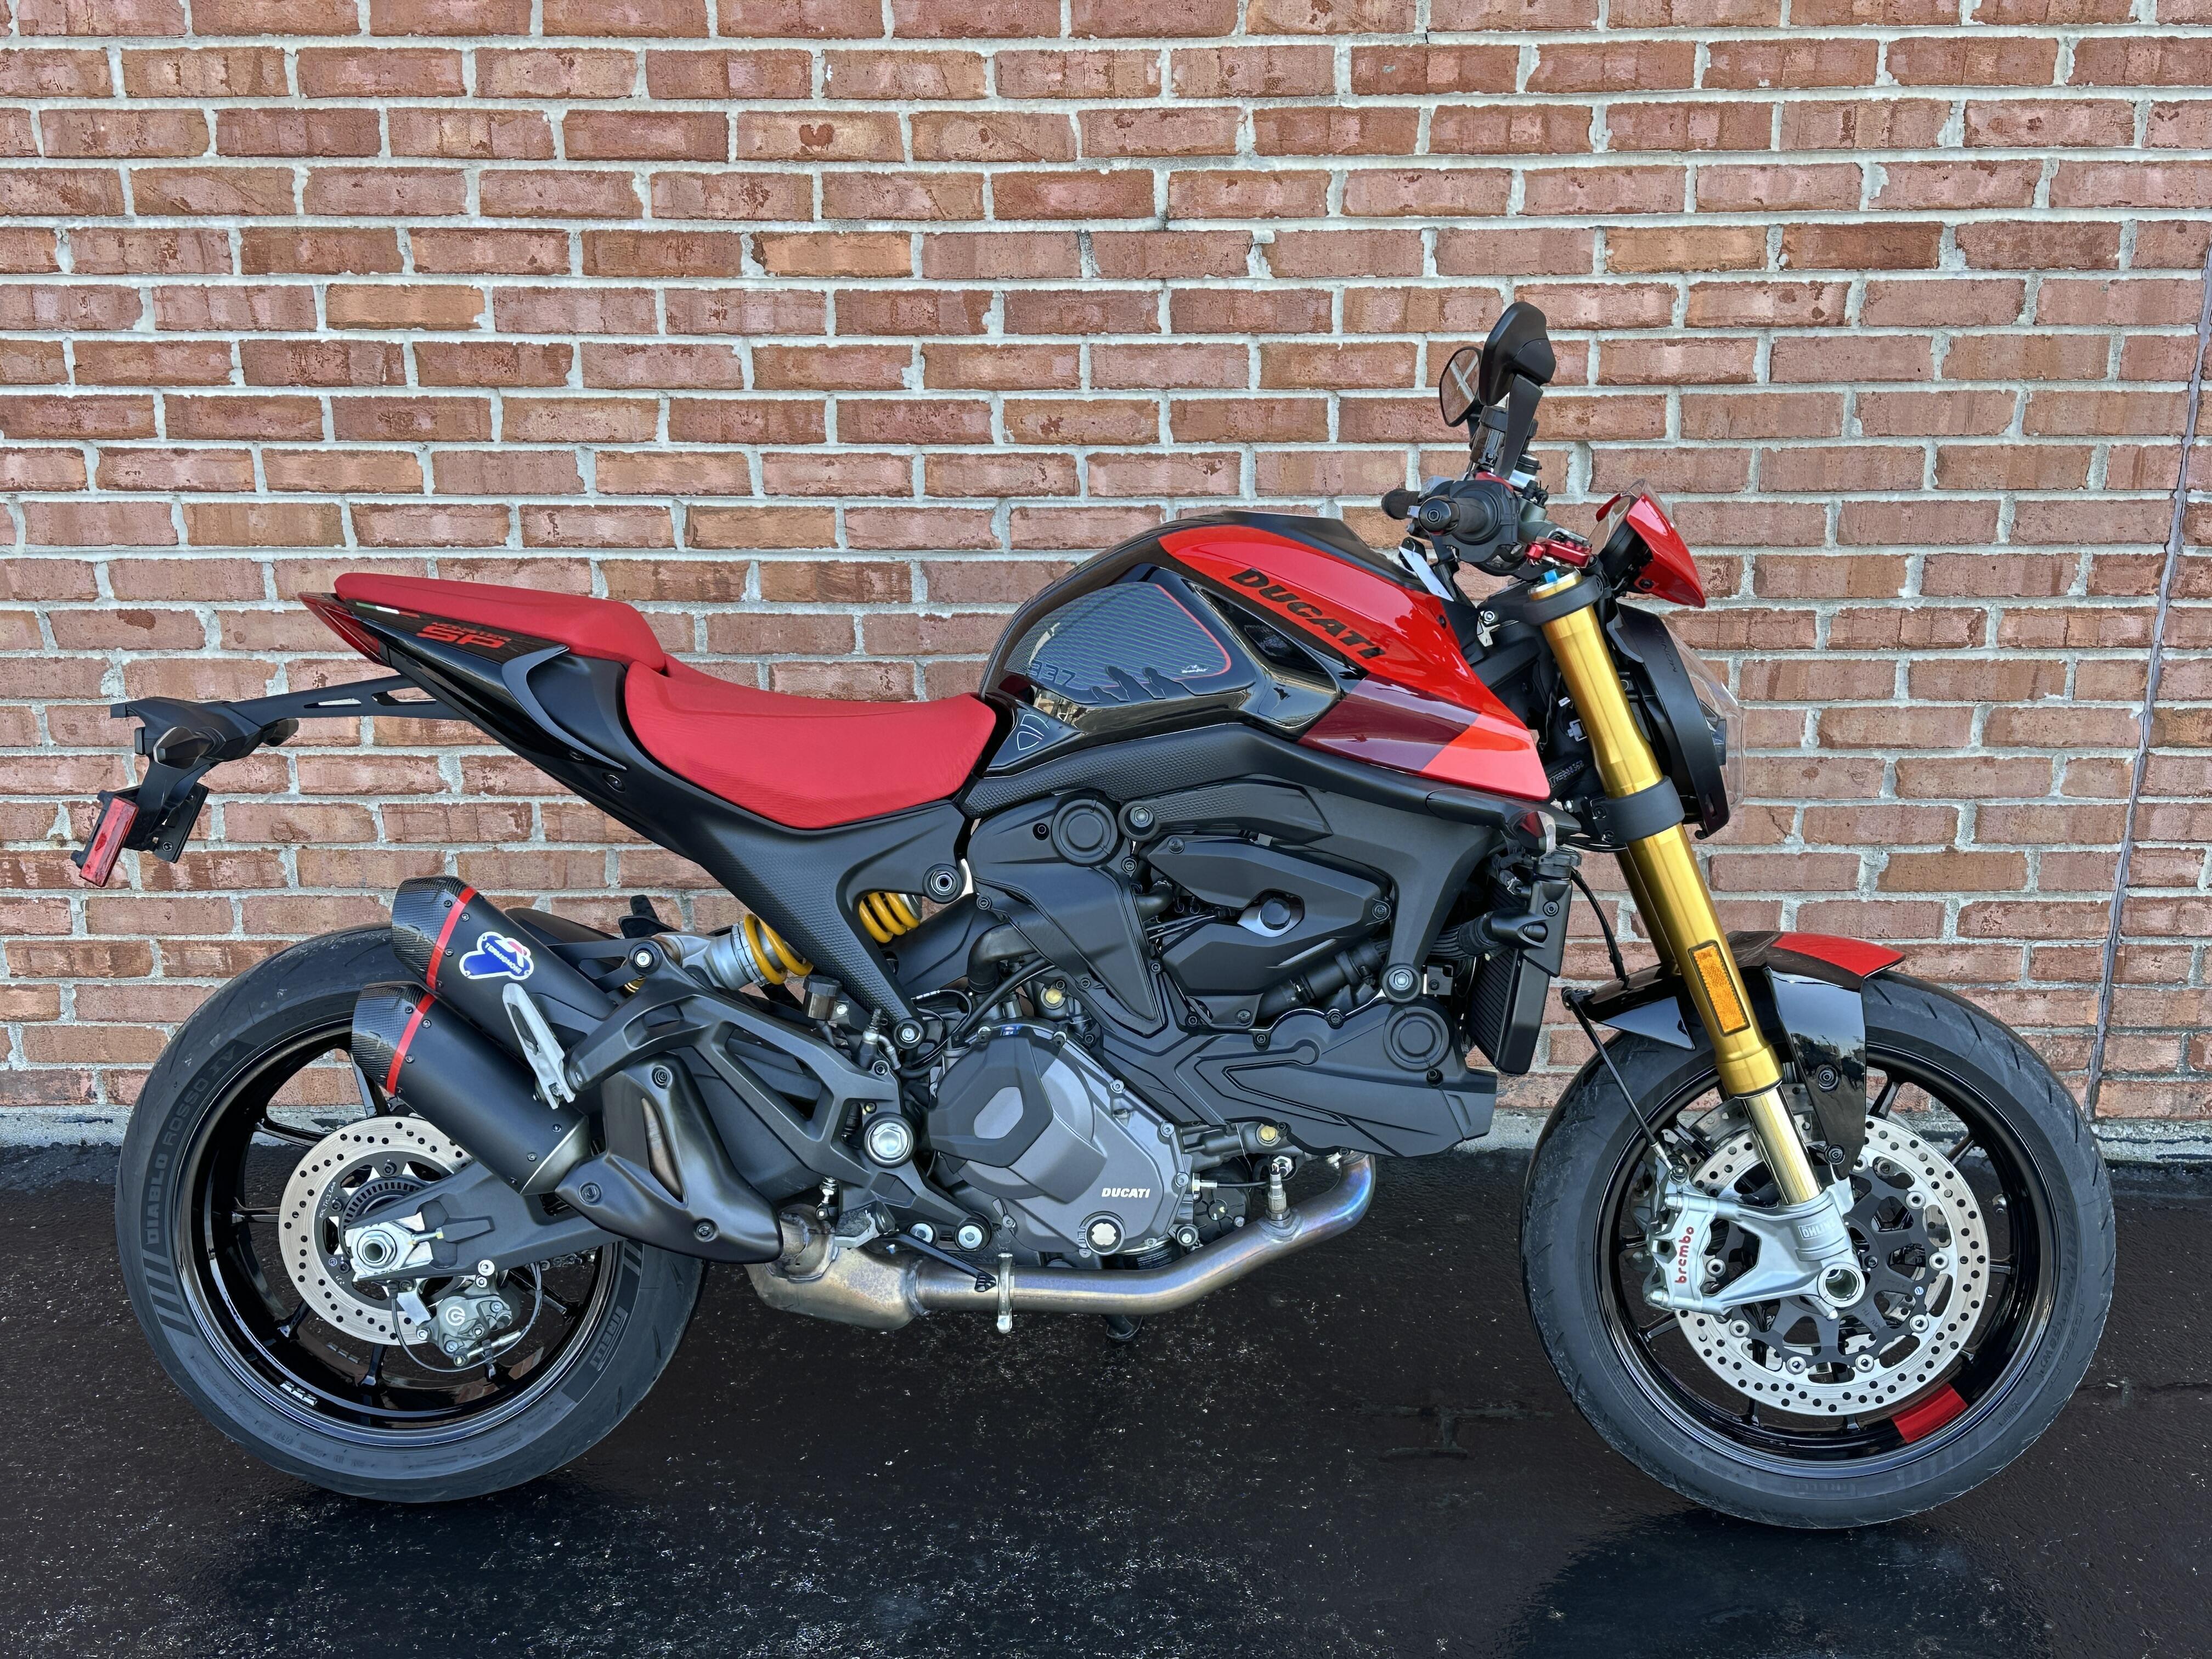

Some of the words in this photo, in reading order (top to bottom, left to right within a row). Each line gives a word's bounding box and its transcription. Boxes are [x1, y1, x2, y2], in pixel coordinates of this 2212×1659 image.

[416, 625, 506, 648] SP
[1228, 568, 1386, 659] DUCATI
[145, 1153, 169, 1245] DIABLO
[162, 1077, 209, 1146] ROSSO
[1101, 1187, 1150, 1198] DUCATI
[1674, 1226, 1695, 1284] brembo
[590, 1305, 628, 1372] PIRELLI
